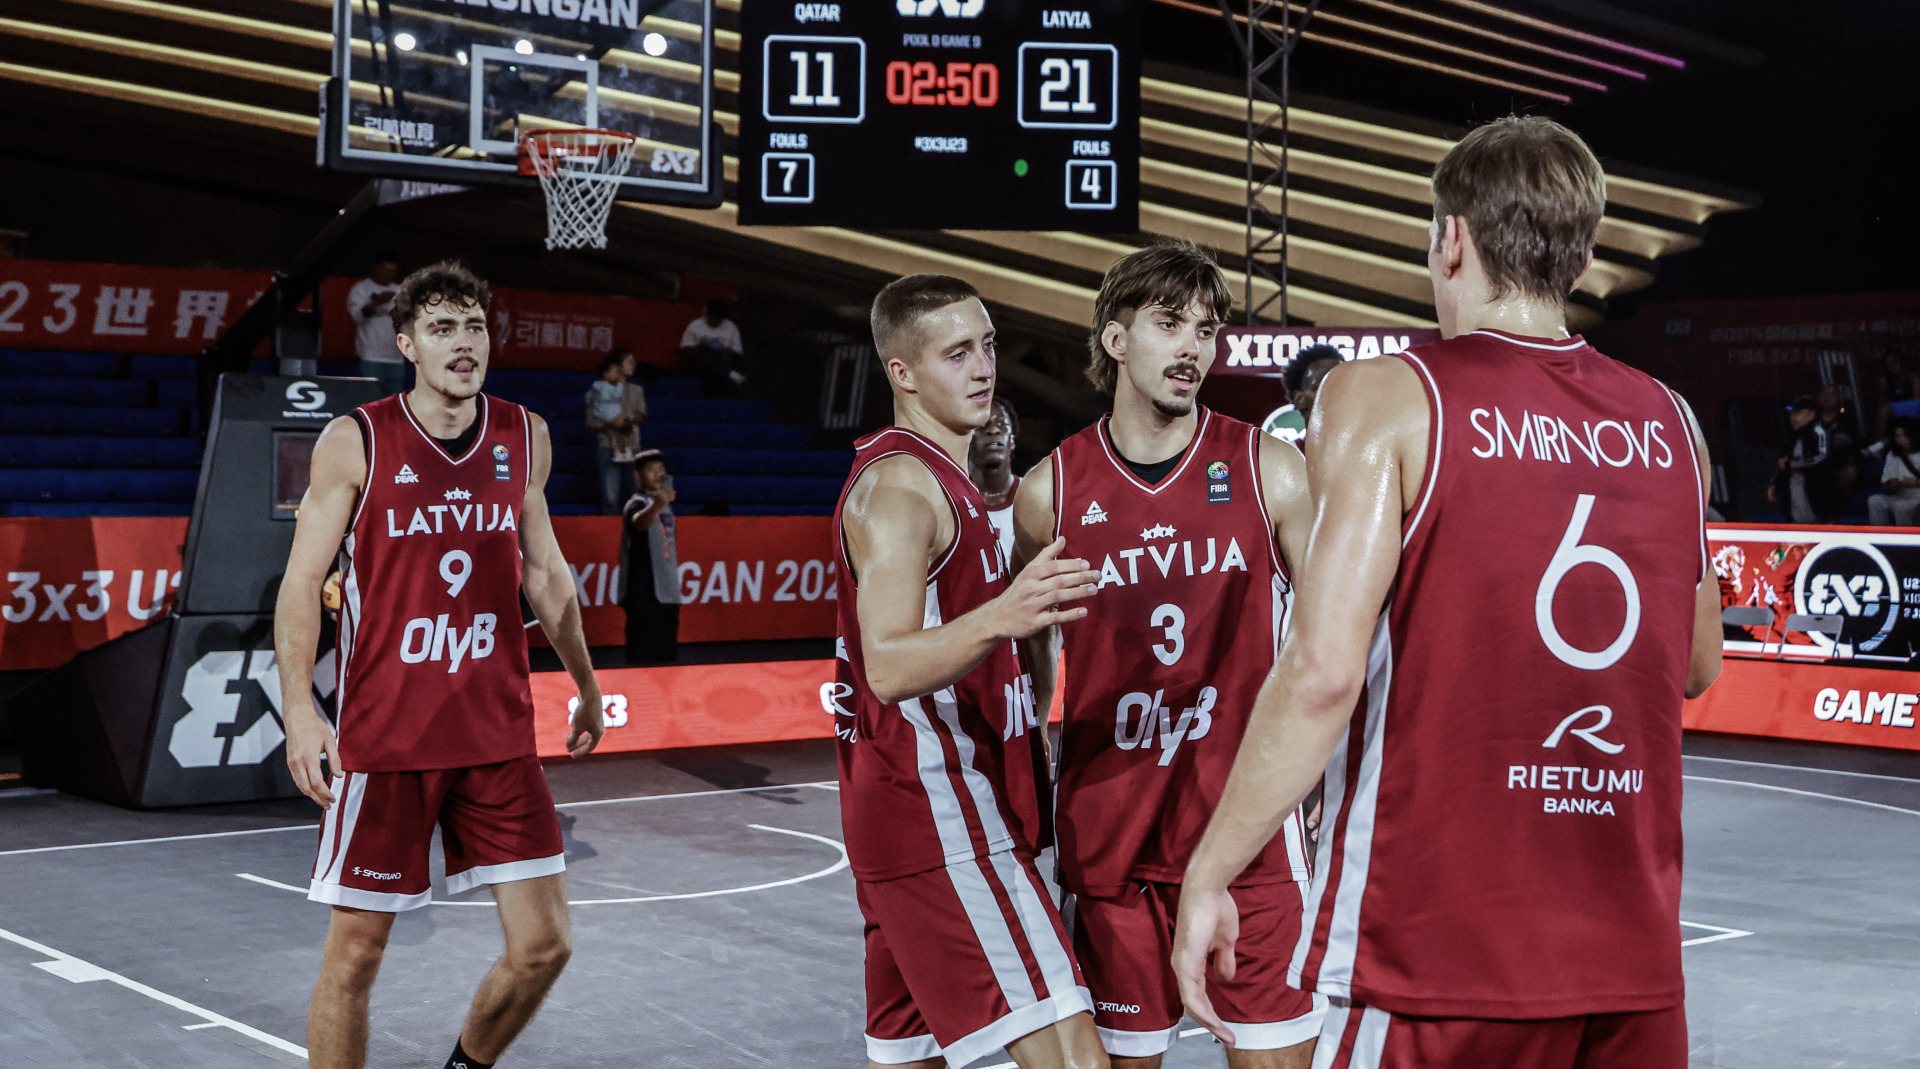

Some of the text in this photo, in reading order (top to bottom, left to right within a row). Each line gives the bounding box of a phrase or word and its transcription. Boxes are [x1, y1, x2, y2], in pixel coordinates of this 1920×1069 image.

[794, 3, 841, 23] QATAR
[1042, 10, 1092, 29] LATVIA
[941, 34, 970, 48] GAME
[789, 51, 840, 107] 11
[886, 61, 999, 107] 02:50
[1040, 58, 1096, 113] 21
[769, 132, 809, 149] FOULS
[914, 136, 968, 153] #3X3U23
[1073, 140, 1111, 156] FOULS
[778, 160, 799, 194] 7
[1081, 167, 1102, 200] 4
[1469, 405, 1673, 470] SMIRNOVS
[394, 474, 420, 484] PEAK
[1210, 484, 1228, 493] FIBA
[386, 503, 517, 538] LATVIJA
[1081, 511, 1109, 526] PEAK
[438, 549, 472, 598] 9
[1075, 536, 1248, 590] ATVIJA
[2, 568, 182, 623] 3x3 U
[568, 560, 765, 607] XIGAN
[1535, 493, 1641, 671] 6
[1903, 577, 1920, 590] U2
[1150, 603, 1186, 666] 3
[1813, 687, 1920, 728] GAME
[1507, 764, 1644, 793] RIETUMU
[1543, 797, 1616, 816] BANKA
[362, 868, 402, 880] SPORTLAND
